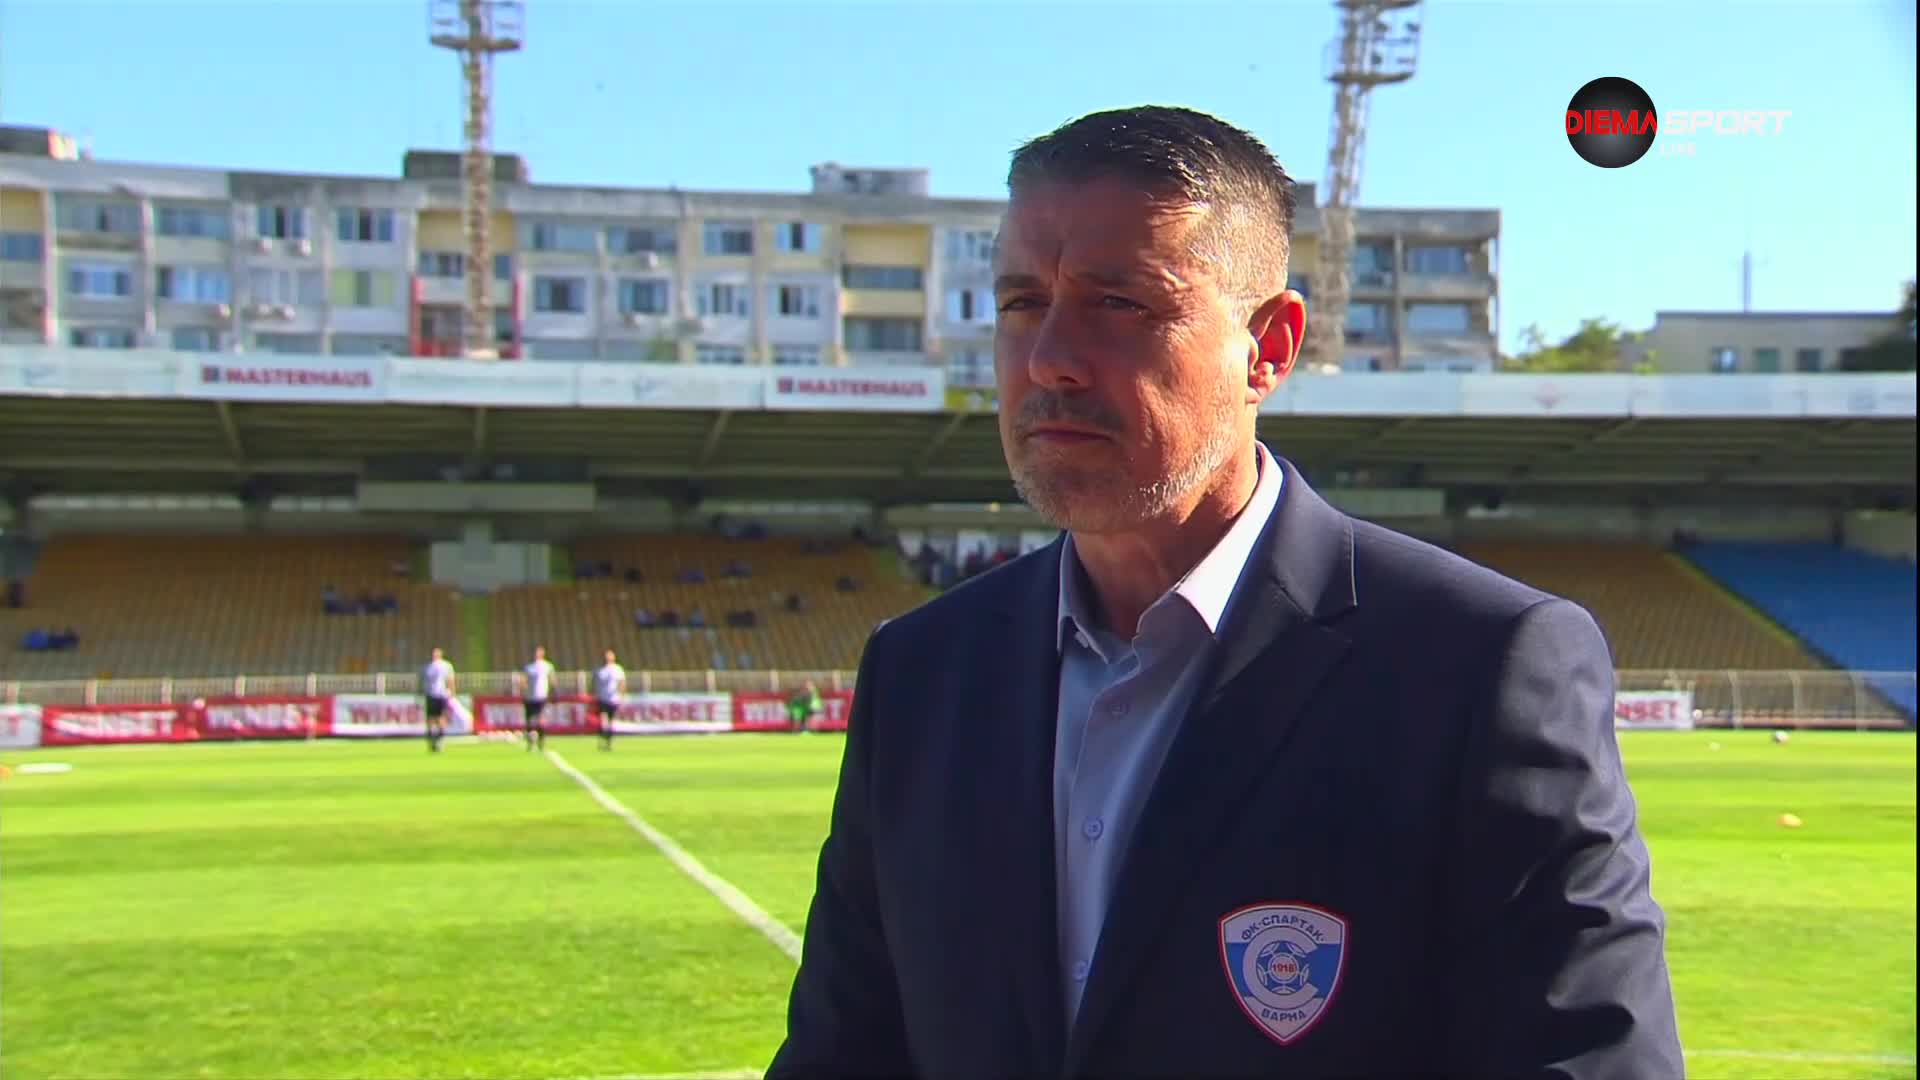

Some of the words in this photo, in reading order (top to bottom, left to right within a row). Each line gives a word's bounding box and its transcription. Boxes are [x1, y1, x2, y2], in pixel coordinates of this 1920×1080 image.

[226, 367, 372, 387] MASTERHAUS
[799, 378, 927, 397] MASTERHAUS
[1272, 963, 1296, 973] 1918
[1261, 1007, 1307, 1022] ВАРНА
